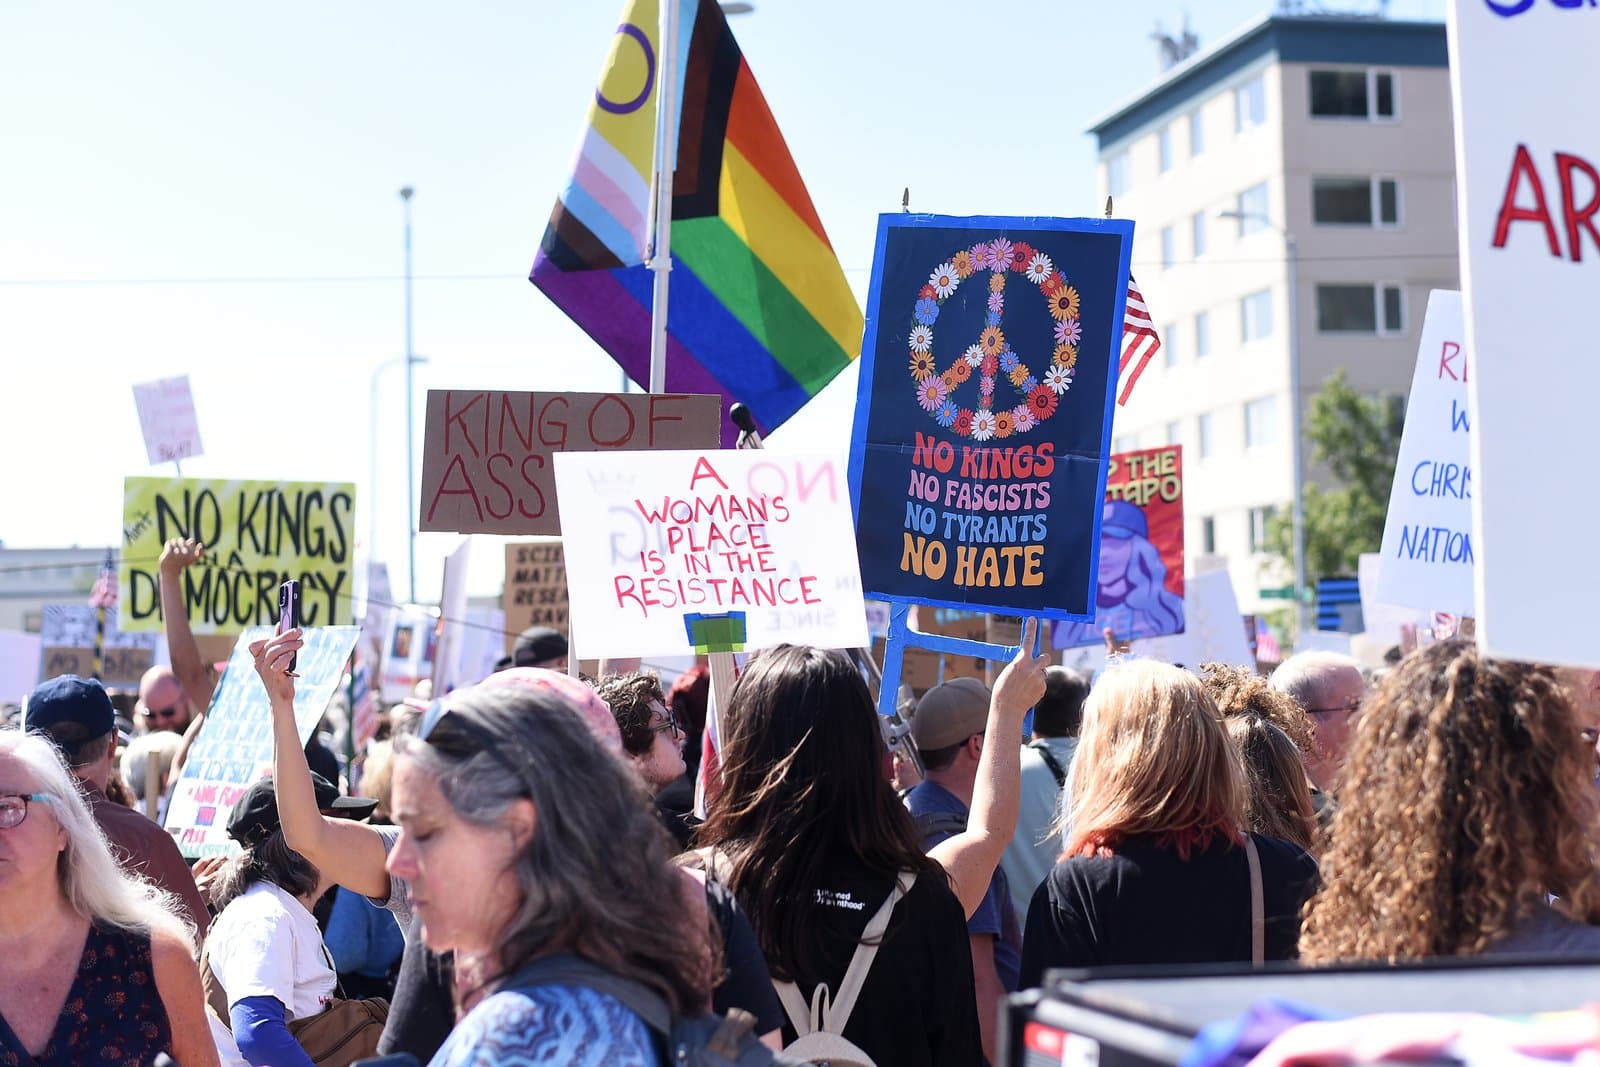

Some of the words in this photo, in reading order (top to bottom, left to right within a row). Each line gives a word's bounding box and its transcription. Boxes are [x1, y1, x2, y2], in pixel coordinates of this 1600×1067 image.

[444, 391, 569, 459] KING
[588, 394, 691, 448] OF
[689, 456, 729, 490] A
[912, 431, 955, 474] NO
[960, 442, 1055, 480] KINGS
[1125, 450, 1177, 480] THE
[634, 493, 790, 525] WOMAN'S
[907, 469, 940, 503] NO
[944, 481, 1052, 511] FASCISTS
[1106, 476, 1182, 507] TAPO
[154, 489, 222, 550] NO
[237, 487, 352, 564] KINGS
[667, 522, 771, 555] PLACE
[904, 501, 937, 535] NO
[942, 512, 1048, 543] TYRANTS
[640, 550, 666, 576] IS
[684, 553, 711, 575] IN
[718, 551, 777, 574] THE
[900, 532, 948, 581] NO
[953, 544, 1046, 587] HATE
[130, 568, 347, 626] DMOCRCY
[613, 575, 823, 618] RESISTANCE
